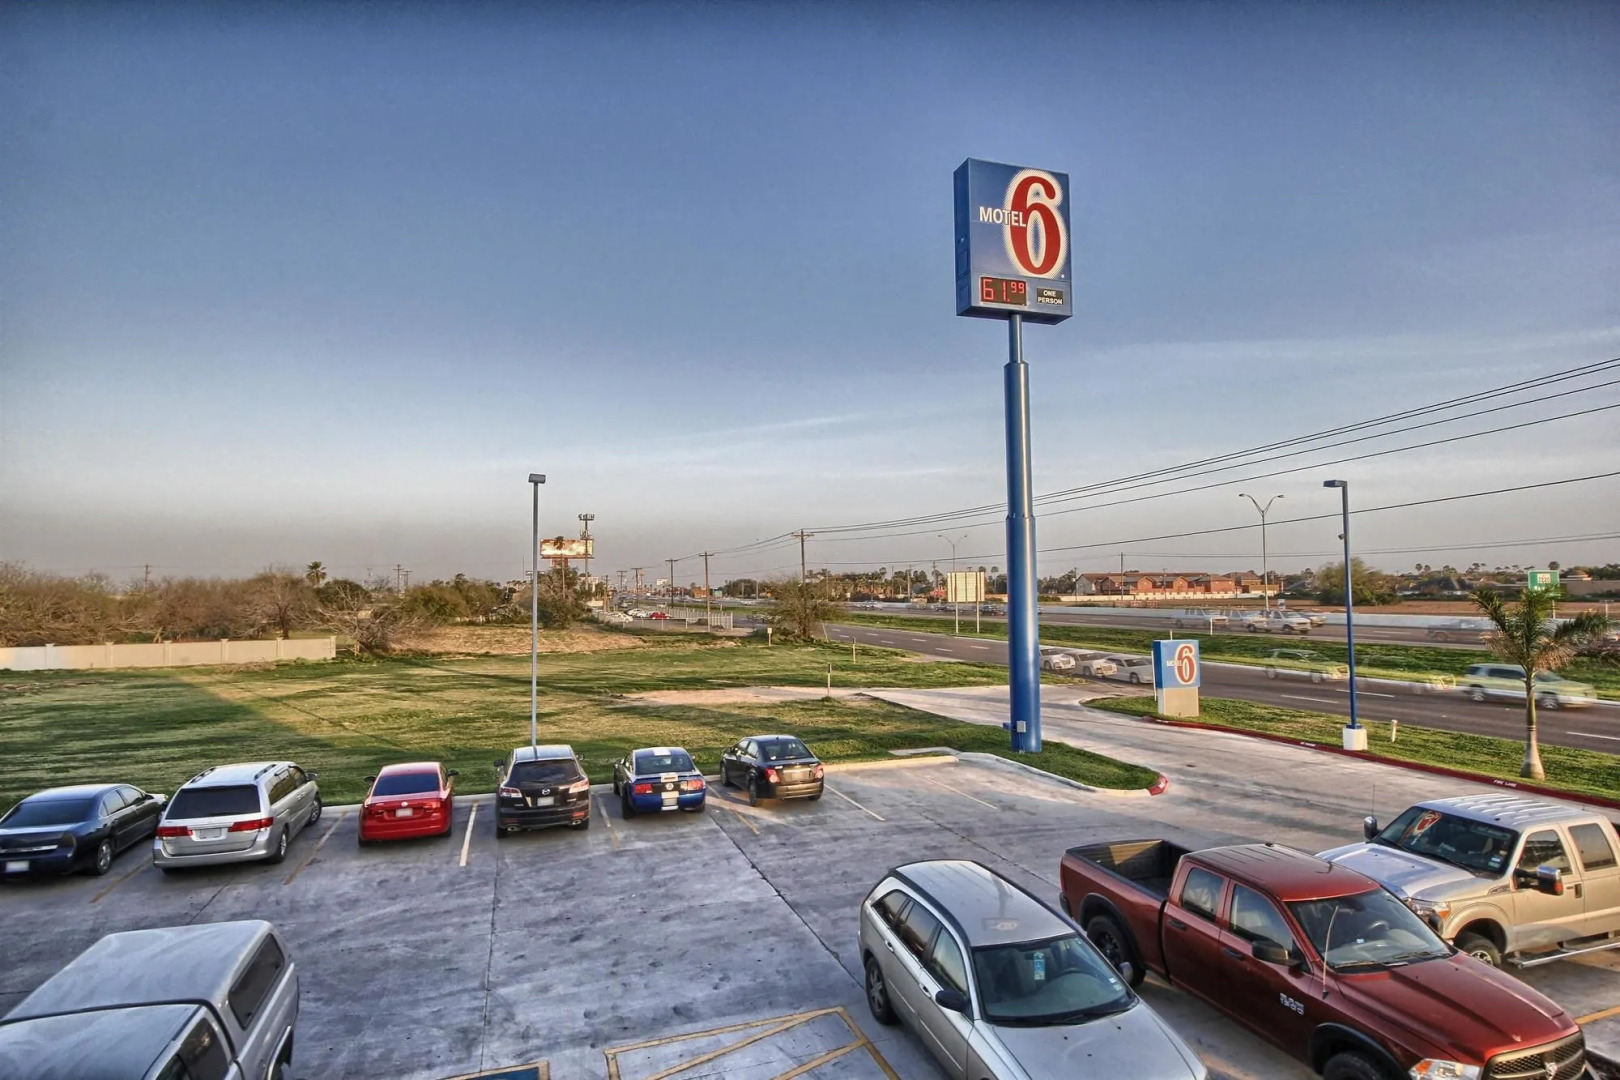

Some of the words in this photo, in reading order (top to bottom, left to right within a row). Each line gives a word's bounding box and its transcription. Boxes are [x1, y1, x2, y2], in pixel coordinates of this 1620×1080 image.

[979, 206, 1027, 227] MOTEL
[1007, 173, 1063, 277] 6
[982, 278, 1025, 302] 61.99
[1037, 296, 1063, 305] PERSON
[1043, 289, 1057, 297] ONE
[1175, 644, 1196, 684] 6
